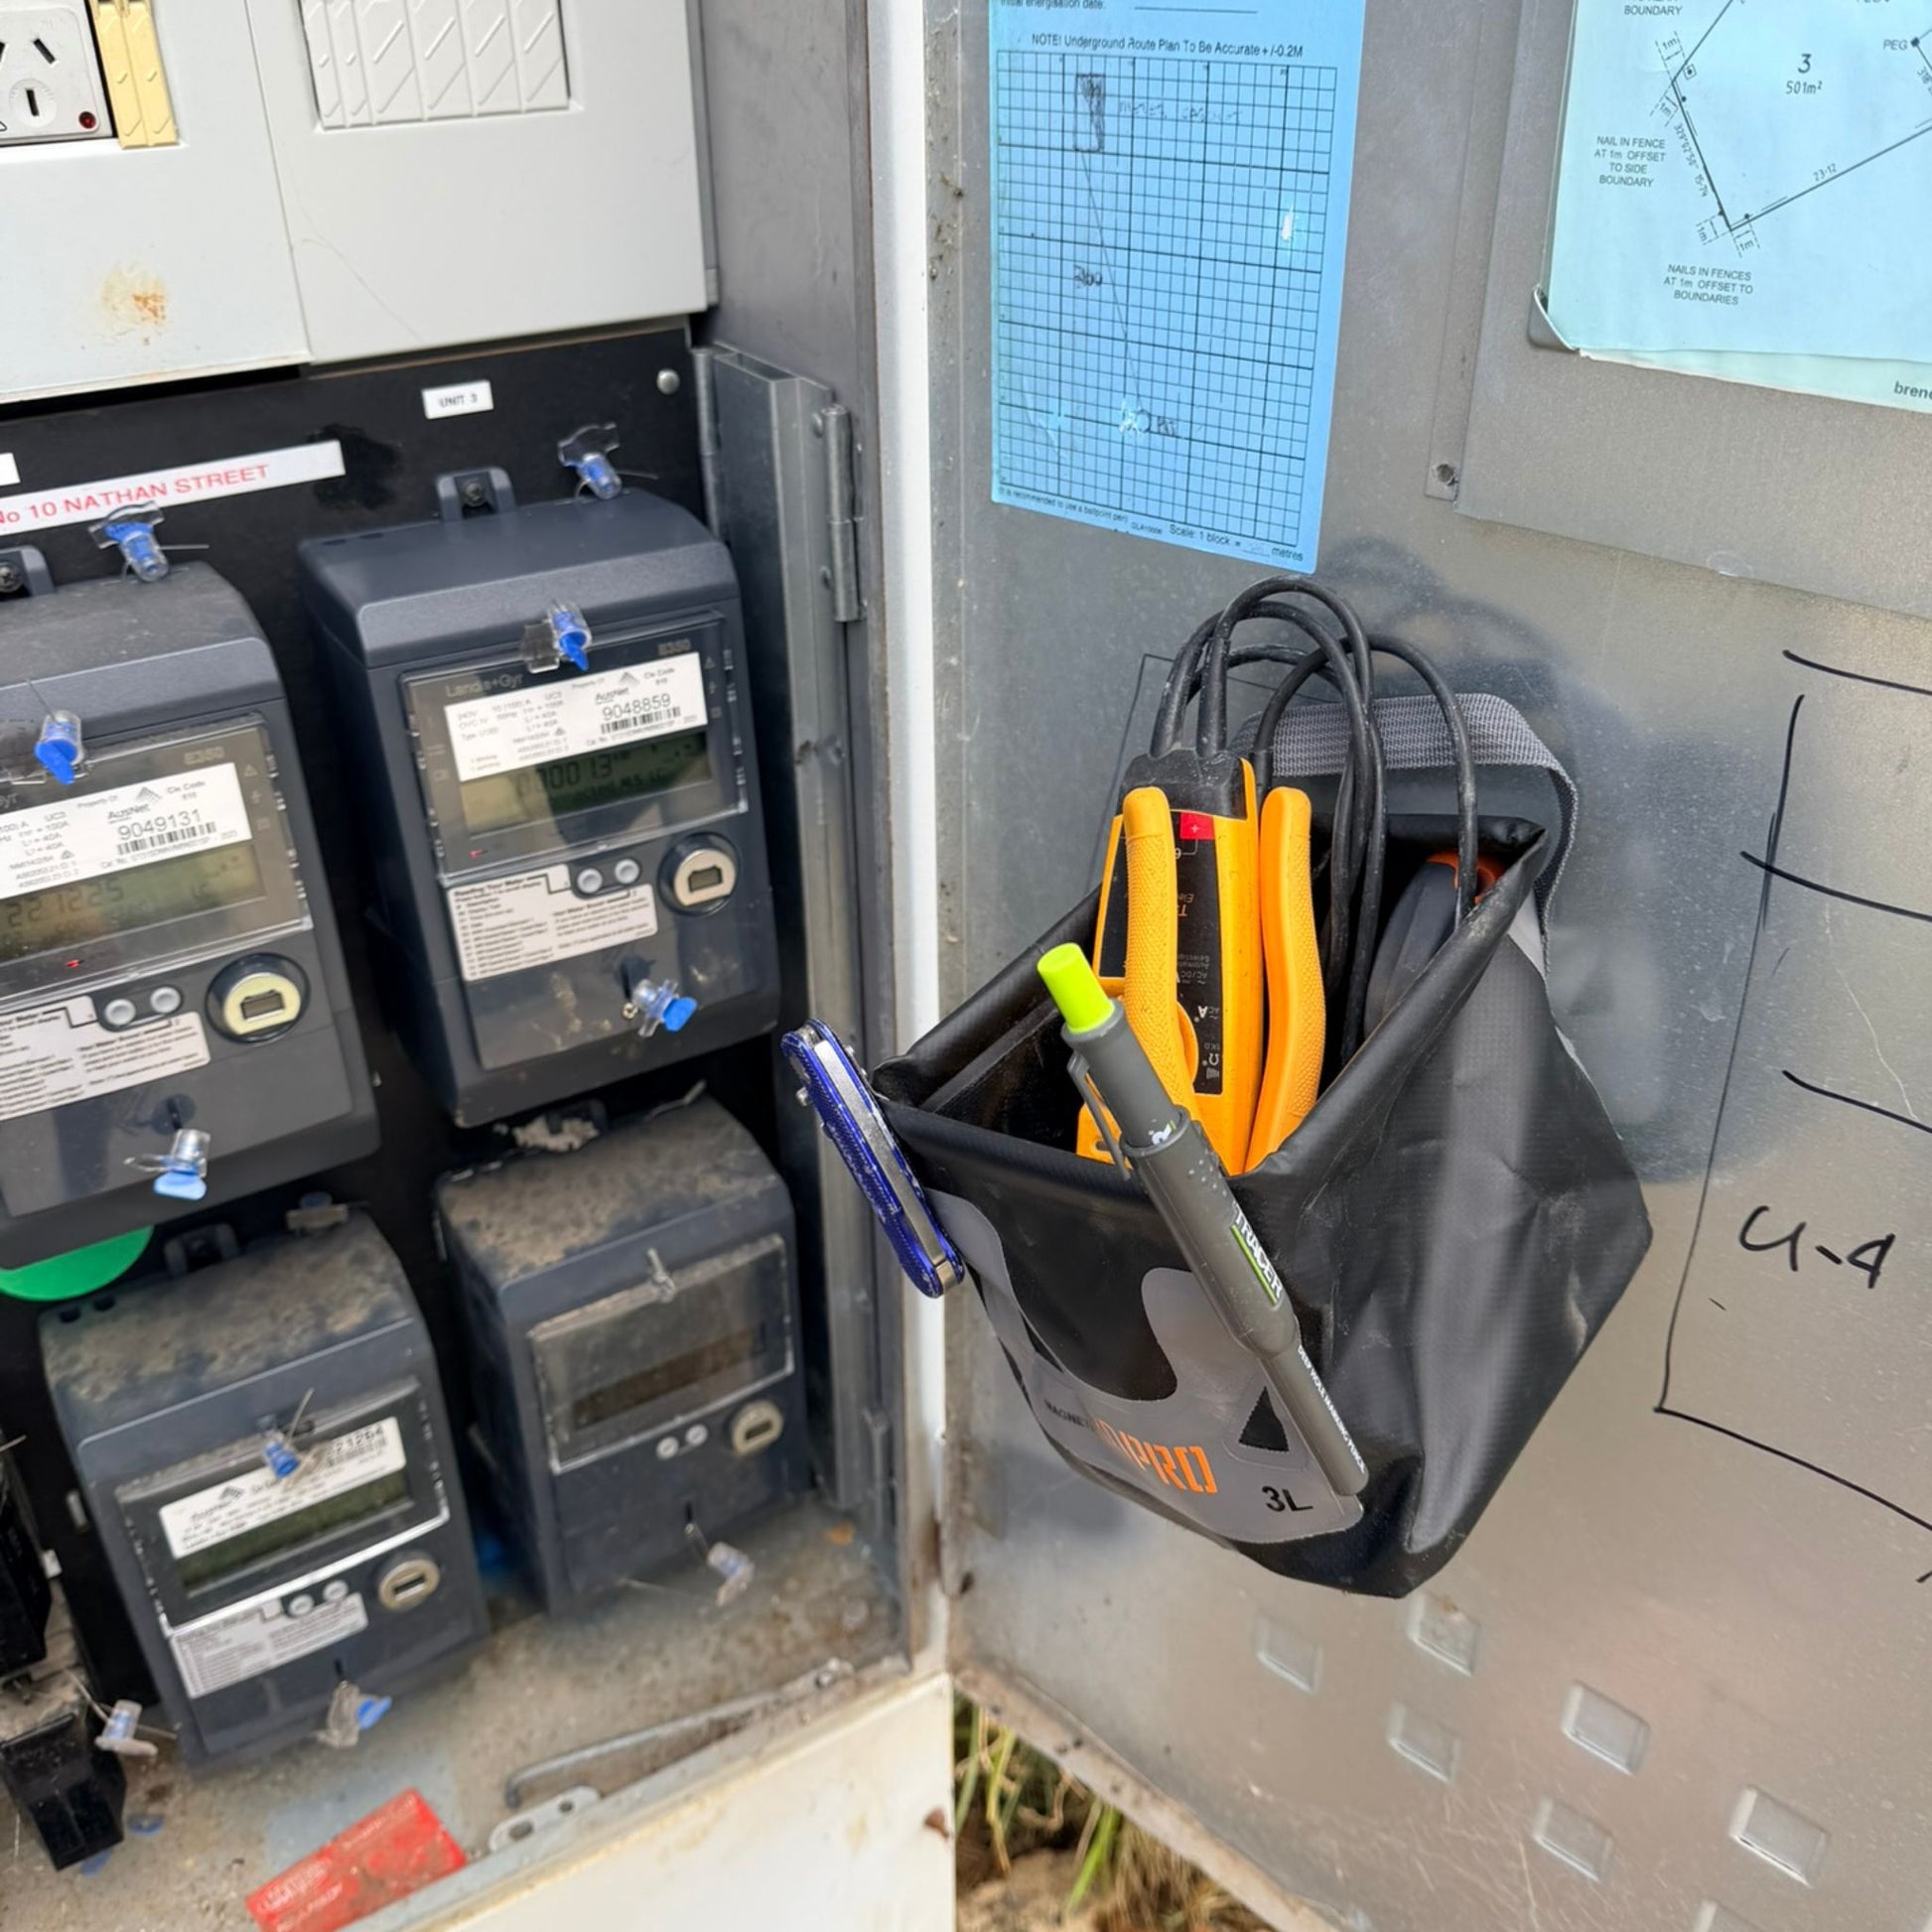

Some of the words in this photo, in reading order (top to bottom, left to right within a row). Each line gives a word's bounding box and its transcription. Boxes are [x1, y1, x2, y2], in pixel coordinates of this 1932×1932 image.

[1624, 5, 1683, 16] BOUNDARY
[1033, 34, 1062, 47] NOTE!
[1064, 35, 1125, 51] Underground
[1127, 38, 1156, 51] Route
[1159, 38, 1180, 52] Plan
[1183, 40, 1195, 53] To
[1198, 41, 1212, 54] Be
[1214, 42, 1260, 56] Accurate
[1883, 39, 1908, 51] PEG
[1797, 54, 1812, 73] 3
[1596, 136, 1618, 146] NAIL
[1619, 137, 1629, 147] IN
[1632, 138, 1665, 149] FENCE
[1594, 149, 1606, 158] AT
[1609, 150, 1622, 159] 1m
[1627, 150, 1666, 162] OFFSET
[1609, 163, 1622, 172] TO
[1625, 163, 1647, 174] SIDE
[1599, 175, 1654, 187] BOUNDARY
[1668, 264, 1697, 275] NAILS
[1699, 267, 1708, 276] IN
[1711, 268, 1751, 281] FENCES
[1663, 276, 1677, 285] AT
[1680, 278, 1693, 287] 1m
[1698, 280, 1737, 292] OFFSET
[1739, 284, 1753, 294] TO
[1674, 290, 1738, 305] BOUNDARIES
[29, 502, 58, 518] 10
[64, 483, 168, 513] NATHAN
[176, 464, 269, 494] STREET
[1199, 531, 1204, 540] 1
[1206, 532, 1230, 546] block
[1272, 548, 1304, 562] metres
[603, 693, 671, 721] 9048859
[118, 809, 202, 840] 9049131
[1234, 1203, 1283, 1298] TRACER
[1262, 1485, 1313, 1512] 3L
